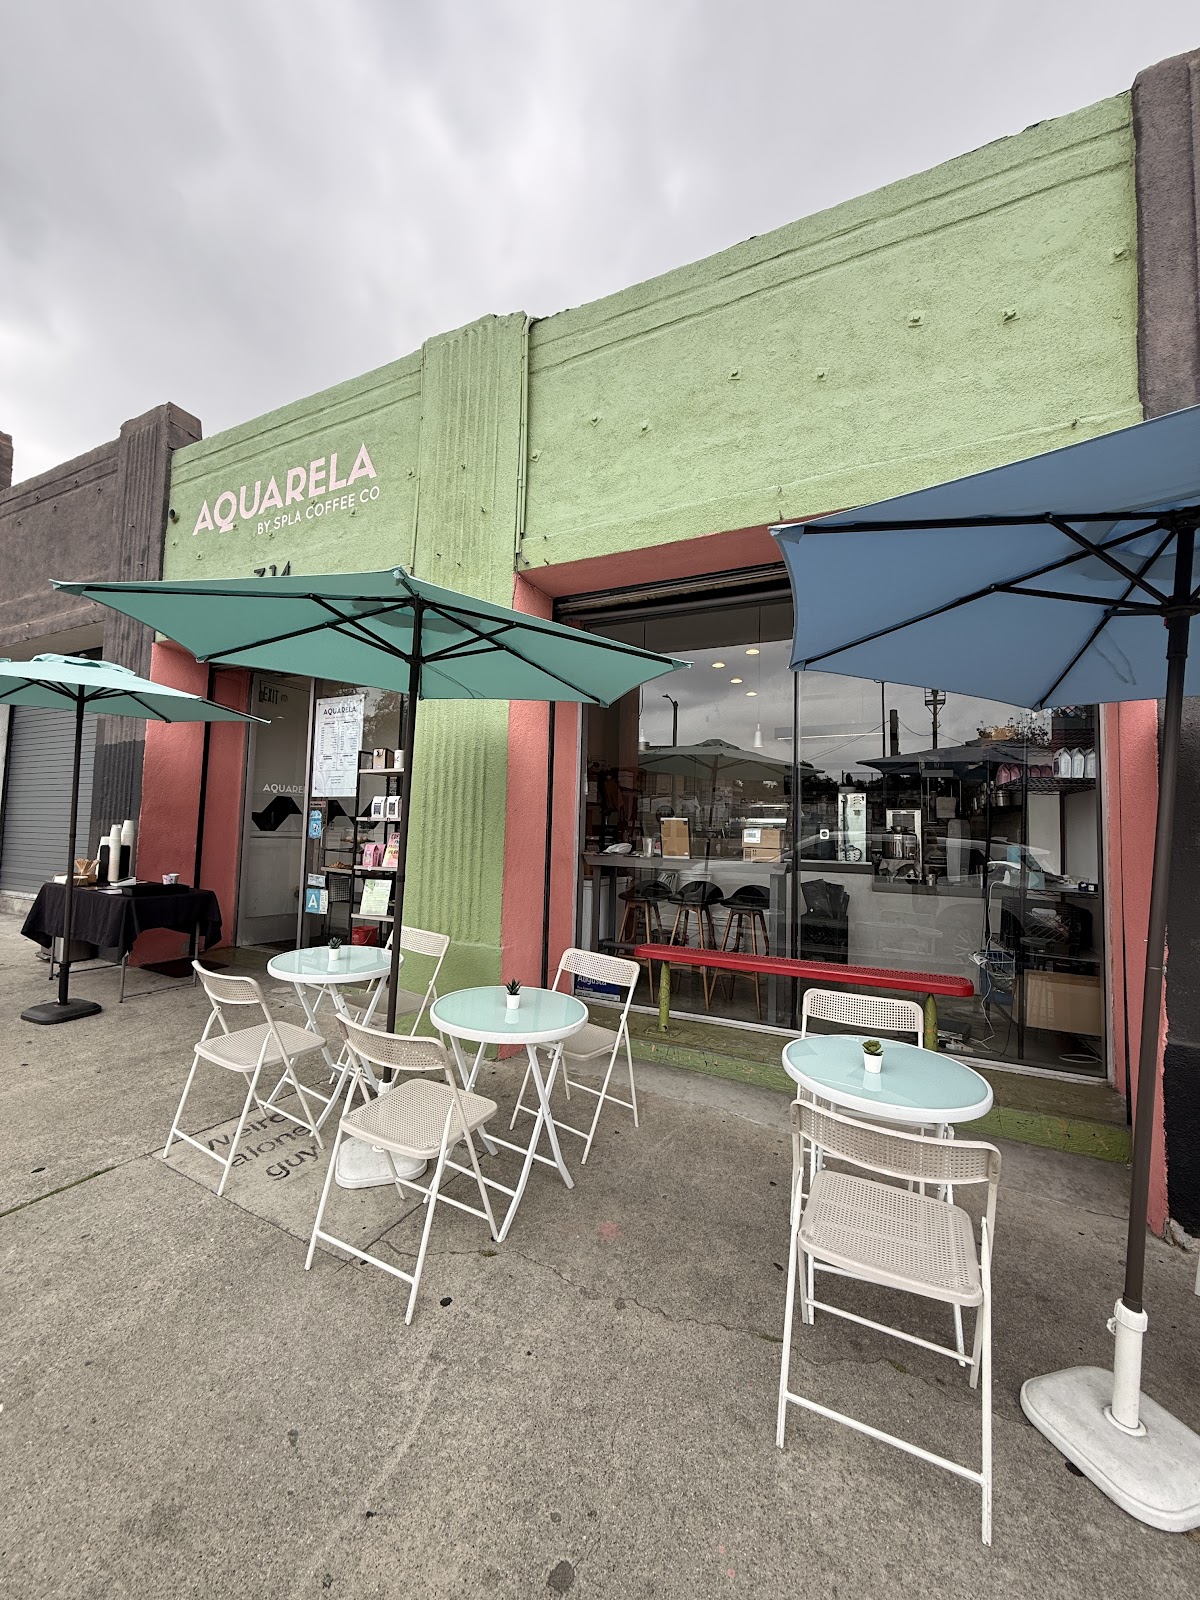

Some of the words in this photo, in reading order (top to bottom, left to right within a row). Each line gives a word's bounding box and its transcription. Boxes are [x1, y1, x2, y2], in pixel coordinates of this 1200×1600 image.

[193, 442, 377, 535] AQUARELA
[257, 520, 271, 535] BY
[273, 511, 301, 529] SPLA
[305, 493, 356, 519] COFFEE
[359, 485, 380, 503] CO
[263, 686, 280, 704] EXIT
[323, 706, 357, 716] AQUARELA
[262, 783, 304, 794] AQUARE
[307, 893, 318, 909] A
[231, 1125, 312, 1168] alone
[265, 1145, 319, 1182] guy
